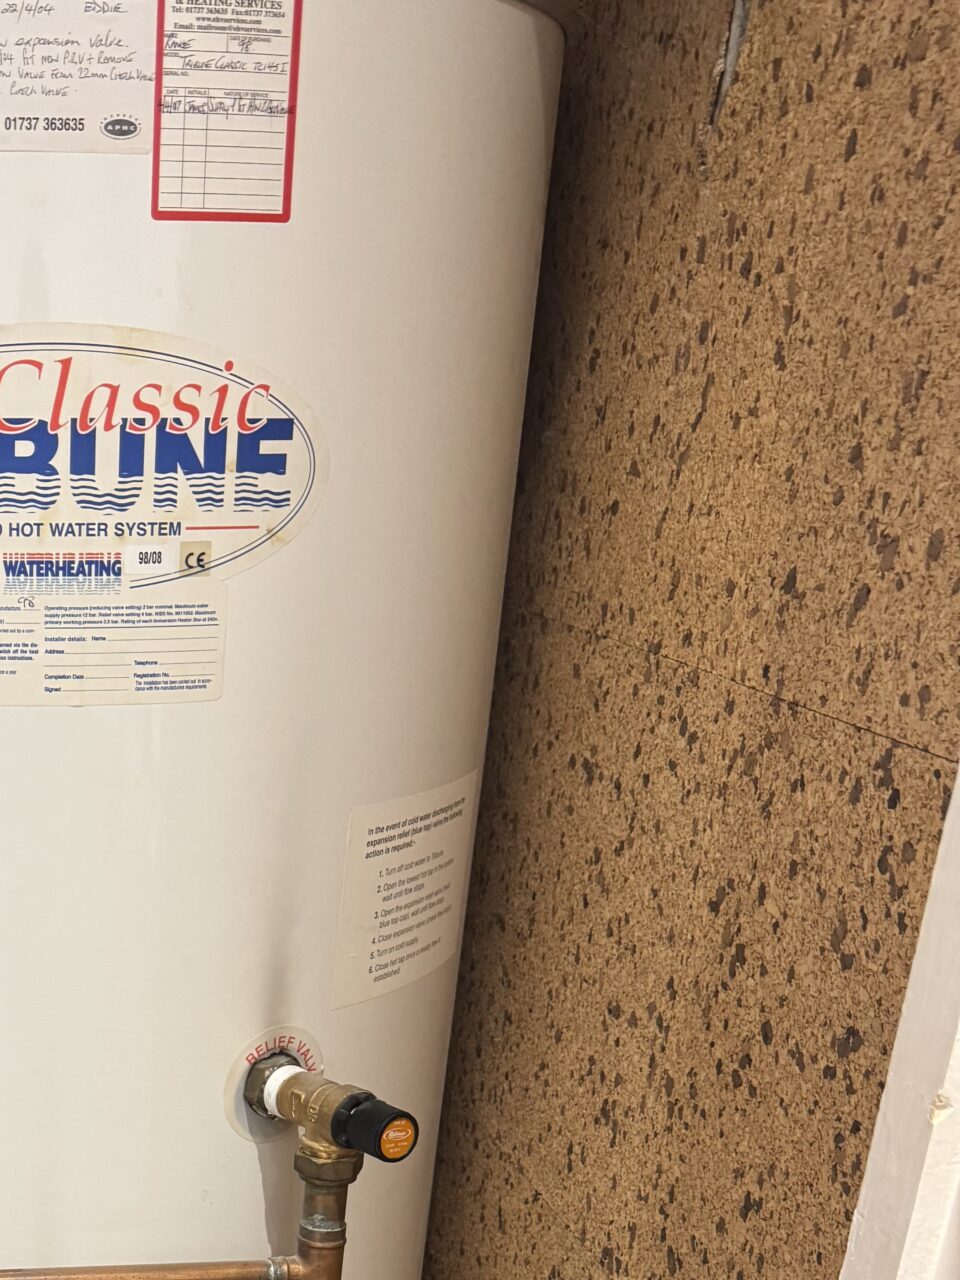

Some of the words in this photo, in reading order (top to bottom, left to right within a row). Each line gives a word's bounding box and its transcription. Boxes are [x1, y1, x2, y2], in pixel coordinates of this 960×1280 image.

[1, 0, 56, 24] 22/4/04
[235, 0, 282, 10] SERVICES
[14, 32, 80, 53] expansion
[4, 117, 39, 131] 01737
[43, 117, 85, 132] 363635
[8, 521, 42, 536] HOT
[49, 521, 108, 536] WATER
[114, 521, 182, 537] SYSTEM
[137, 550, 163, 565] 98/08
[3, 554, 122, 578] WATERHEATING
[44, 673, 71, 681] Completion
[133, 672, 162, 680] Registration
[44, 686, 62, 694] Signed
[374, 826, 385, 835] the
[385, 821, 401, 832] event
[401, 818, 408, 828] of
[407, 816, 419, 826] cold
[366, 834, 397, 848] expansion
[365, 846, 384, 860] action
[384, 846, 390, 854] is
[383, 881, 397, 892] Open
[380, 907, 395, 918] Open
[245, 1036, 296, 1066] RELIEF
